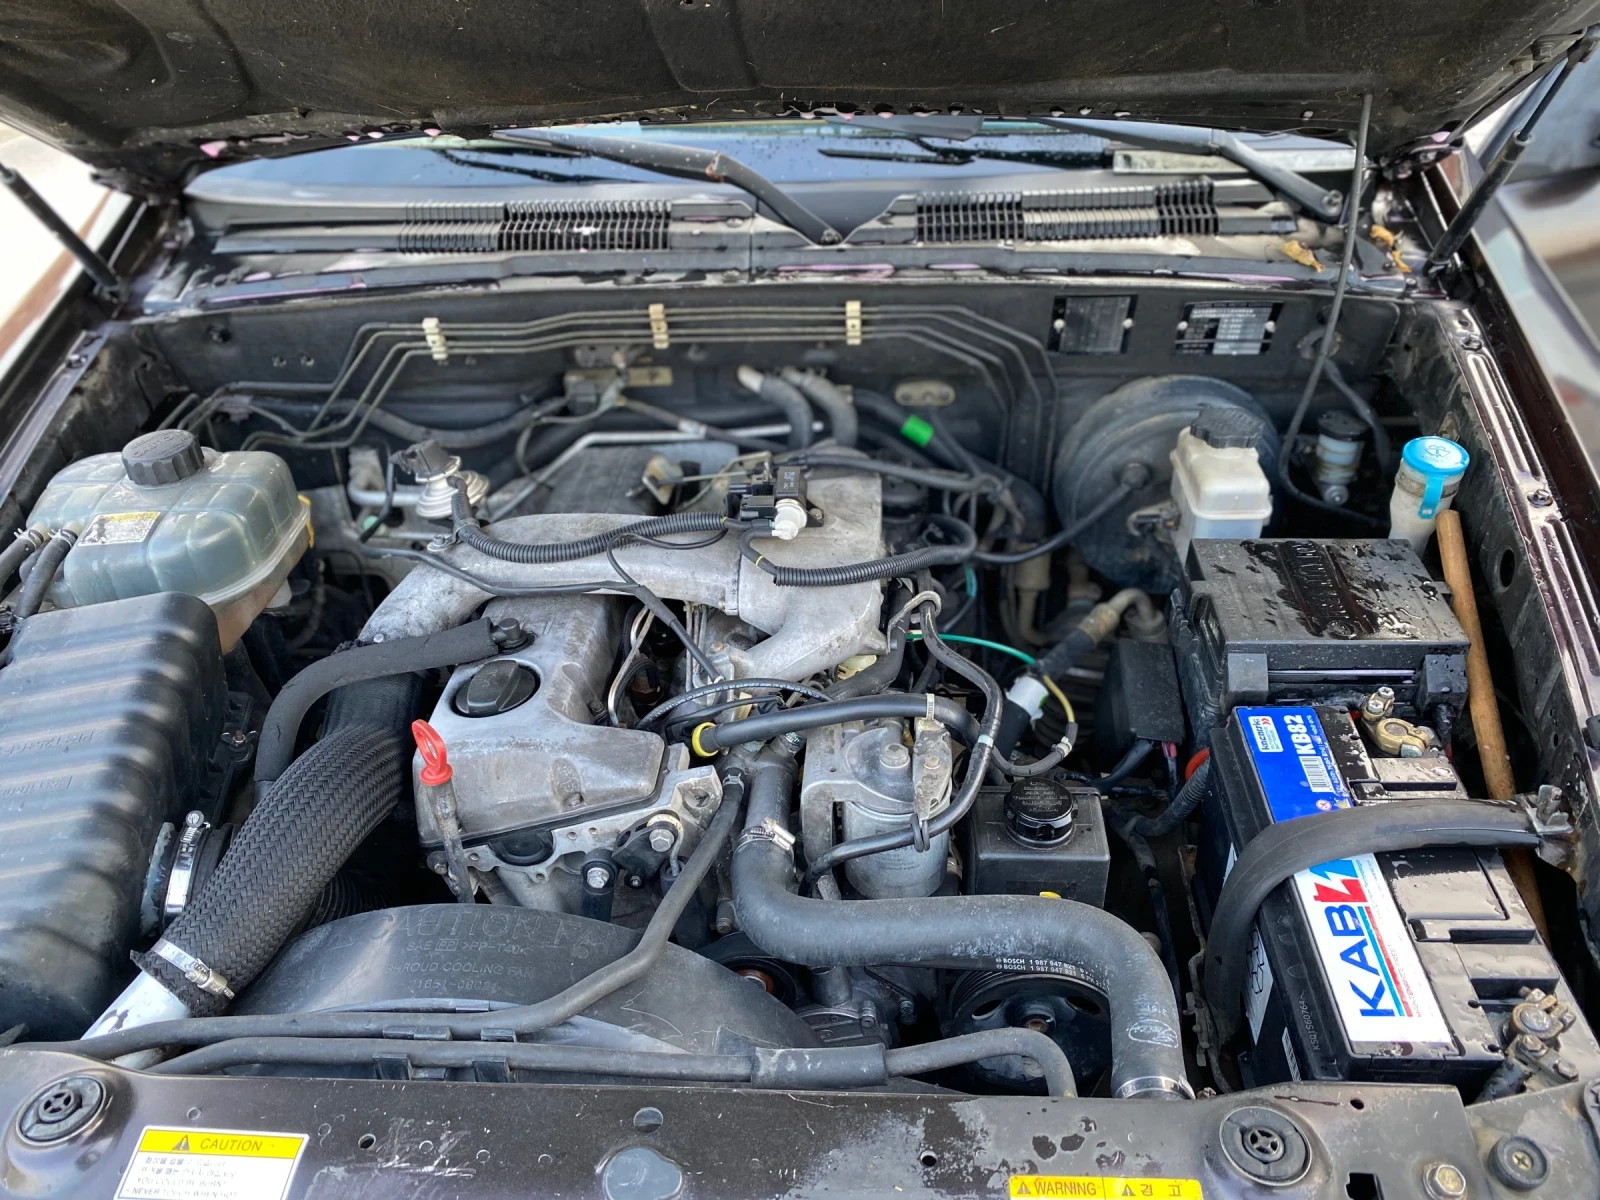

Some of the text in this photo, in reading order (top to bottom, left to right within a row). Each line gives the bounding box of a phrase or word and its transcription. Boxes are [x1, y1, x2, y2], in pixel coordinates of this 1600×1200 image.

[1283, 714, 1316, 755] KB82
[369, 910, 545, 941] CAUTION
[406, 940, 433, 951] SAE
[1324, 903, 1395, 1017] KAB
[442, 962, 503, 975] COOLING
[507, 965, 534, 979] FAN
[200, 1137, 264, 1151] CAUTION
[132, 1187, 160, 1195] NEVER
[1034, 1181, 1097, 1196] WARNING
